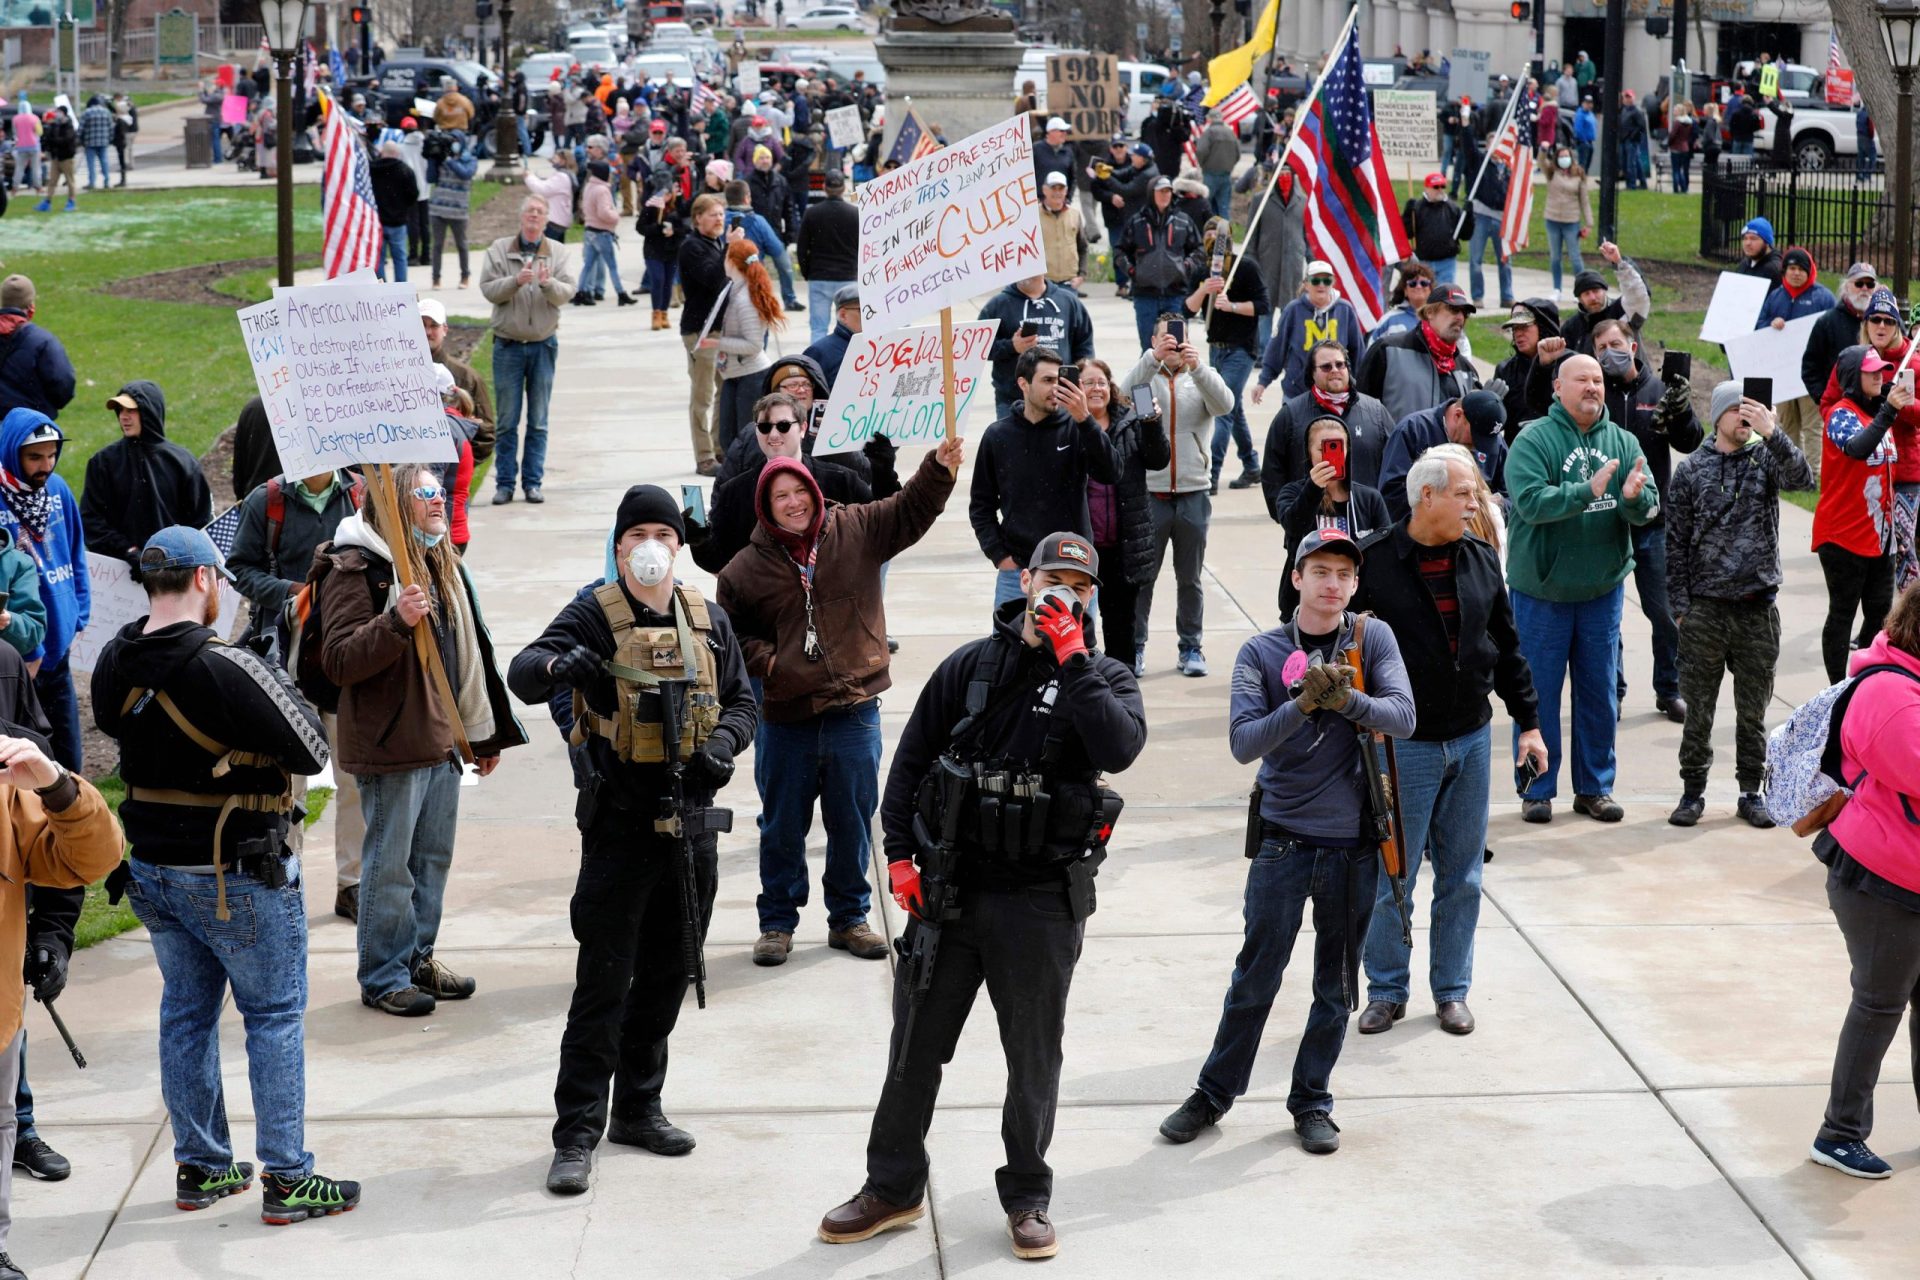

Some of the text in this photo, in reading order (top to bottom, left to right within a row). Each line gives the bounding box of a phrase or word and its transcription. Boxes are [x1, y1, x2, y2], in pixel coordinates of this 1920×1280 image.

[1050, 57, 1111, 82] 1984
[1070, 84, 1105, 109] NO
[936, 116, 1026, 174] OPPRESSION
[862, 204, 900, 236] COME
[916, 178, 951, 205] THIS
[987, 155, 1004, 178] IT
[1003, 141, 1032, 168] WILL
[863, 171, 1039, 264] BE IN THE GUISE
[862, 238, 938, 287] OF FIGHTING
[884, 260, 971, 313] FOREIGN
[980, 225, 1040, 273] ENEMY
[242, 308, 280, 334] THOSE
[288, 296, 346, 328] America
[290, 331, 418, 360] be destroyed from the
[1304, 319, 1338, 351] M
[408, 356, 425, 367] and
[345, 378, 386, 397] freedoms
[385, 377, 396, 391] it
[859, 371, 880, 397] is
[304, 402, 323, 423] be
[324, 401, 377, 423] because
[393, 386, 439, 413] DESTROY
[307, 424, 376, 455] Destroyed
